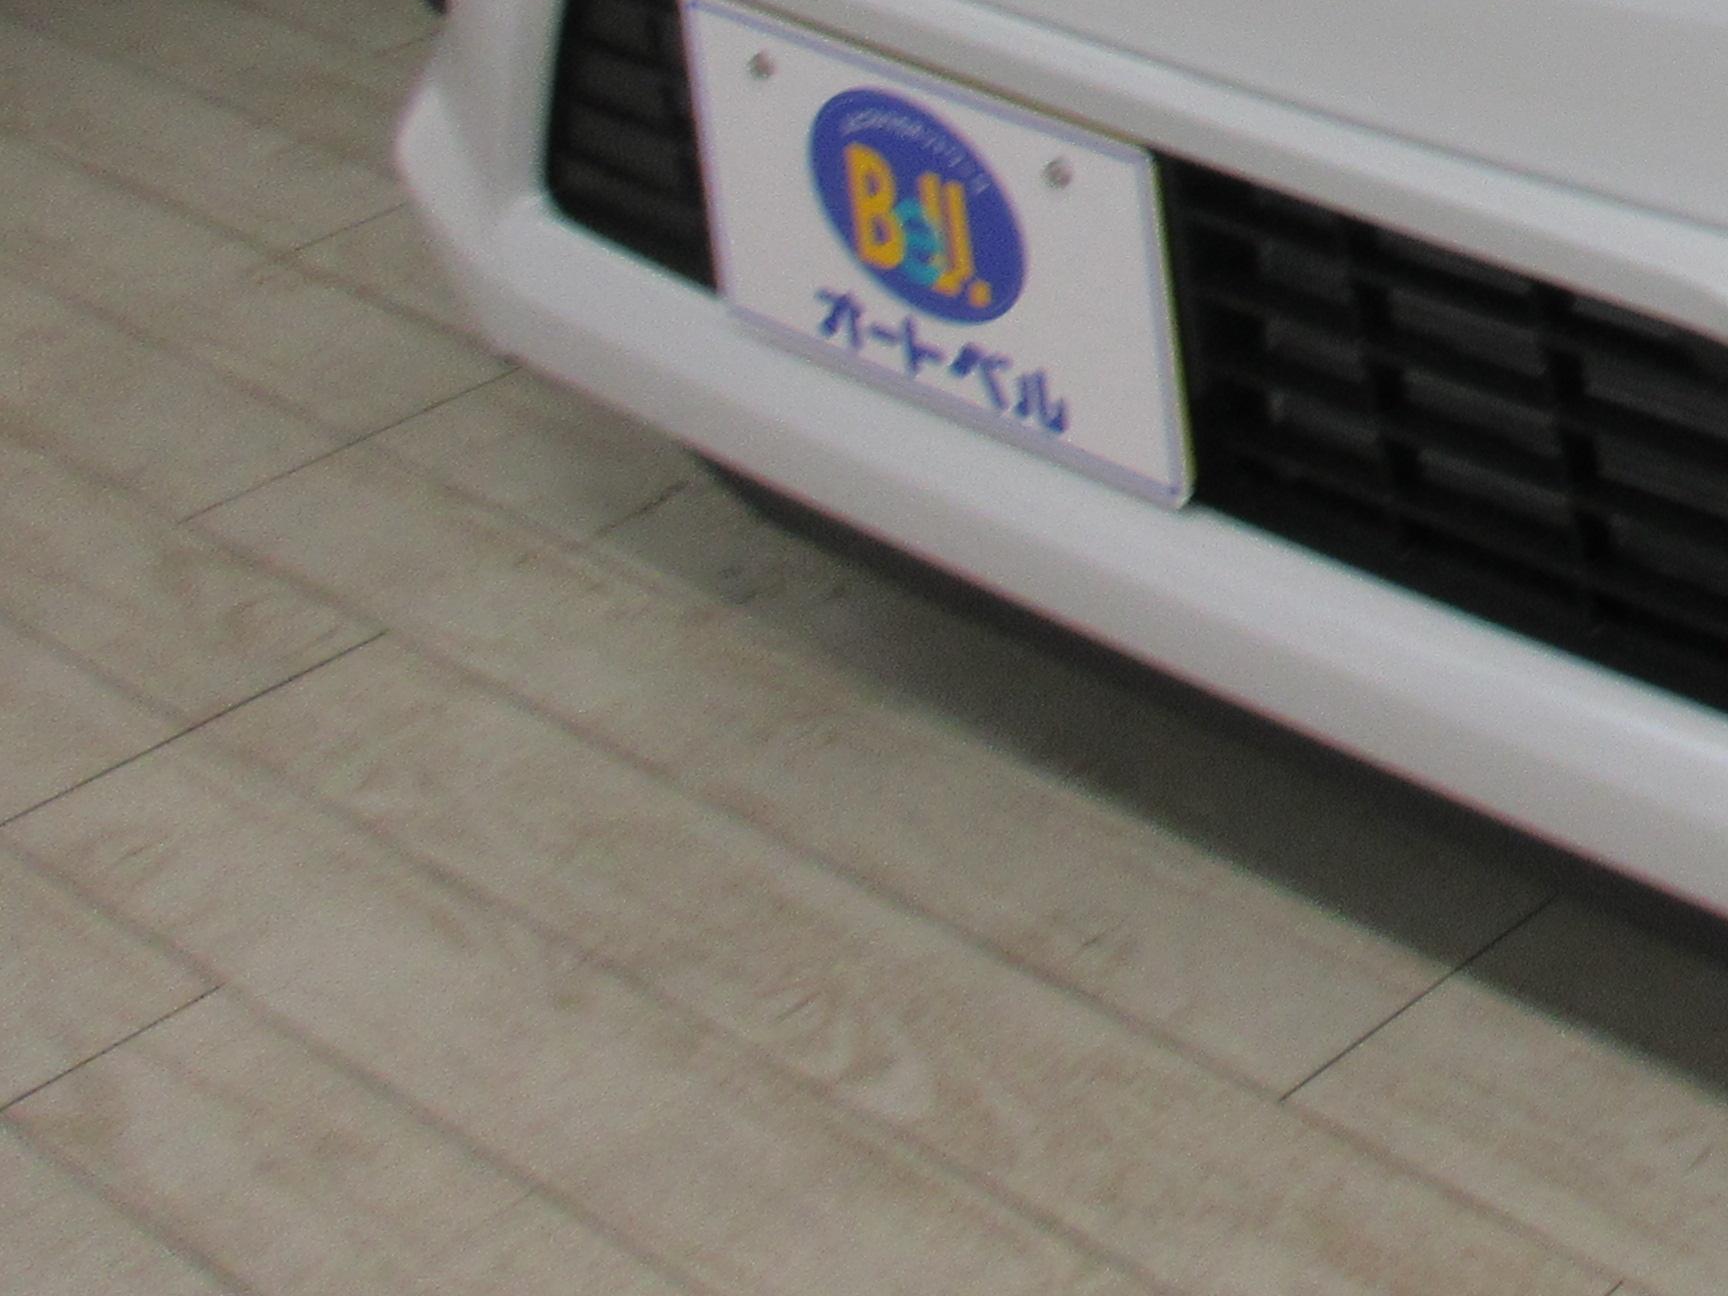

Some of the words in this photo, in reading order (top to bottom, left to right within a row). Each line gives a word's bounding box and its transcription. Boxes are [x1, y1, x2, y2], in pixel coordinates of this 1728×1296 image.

[814, 288, 1070, 435] オートベル
